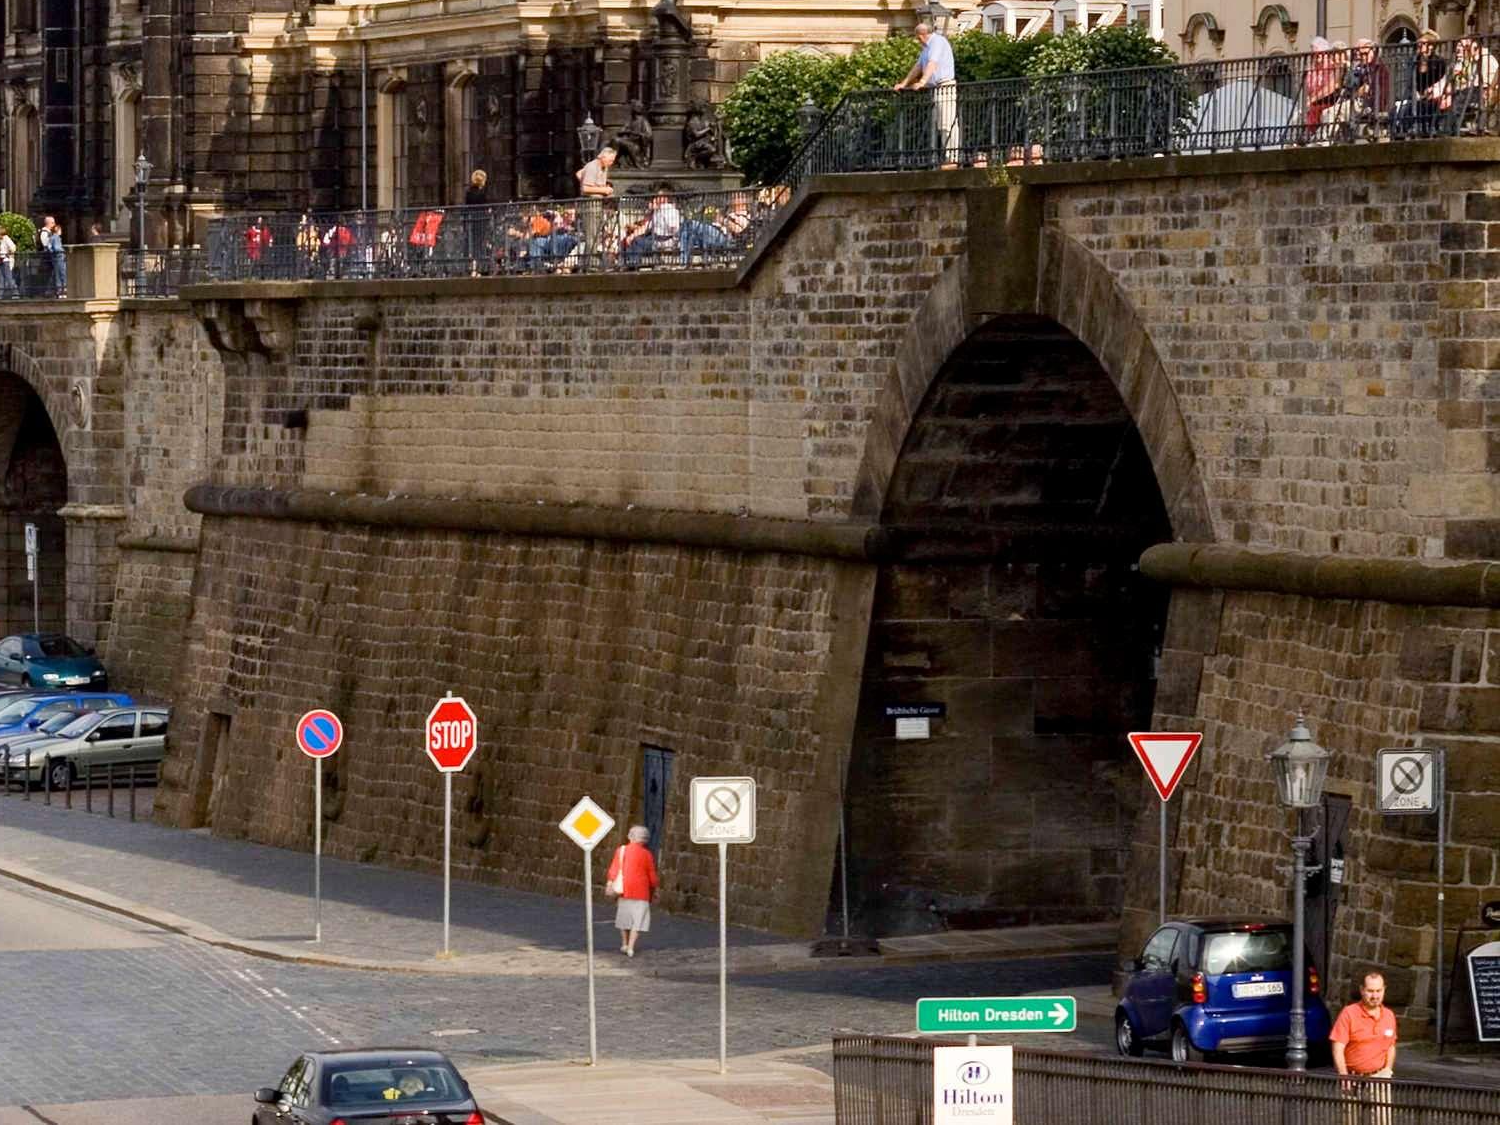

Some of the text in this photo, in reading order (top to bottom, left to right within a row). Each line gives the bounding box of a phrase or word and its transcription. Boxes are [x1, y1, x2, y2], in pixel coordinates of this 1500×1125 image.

[431, 720, 472, 750] STOP
[1394, 796, 1421, 807] ZONE
[708, 824, 737, 835] ZONE
[938, 1007, 1043, 1022] Hilton Dresden
[943, 1088, 1003, 1104] Hilton
